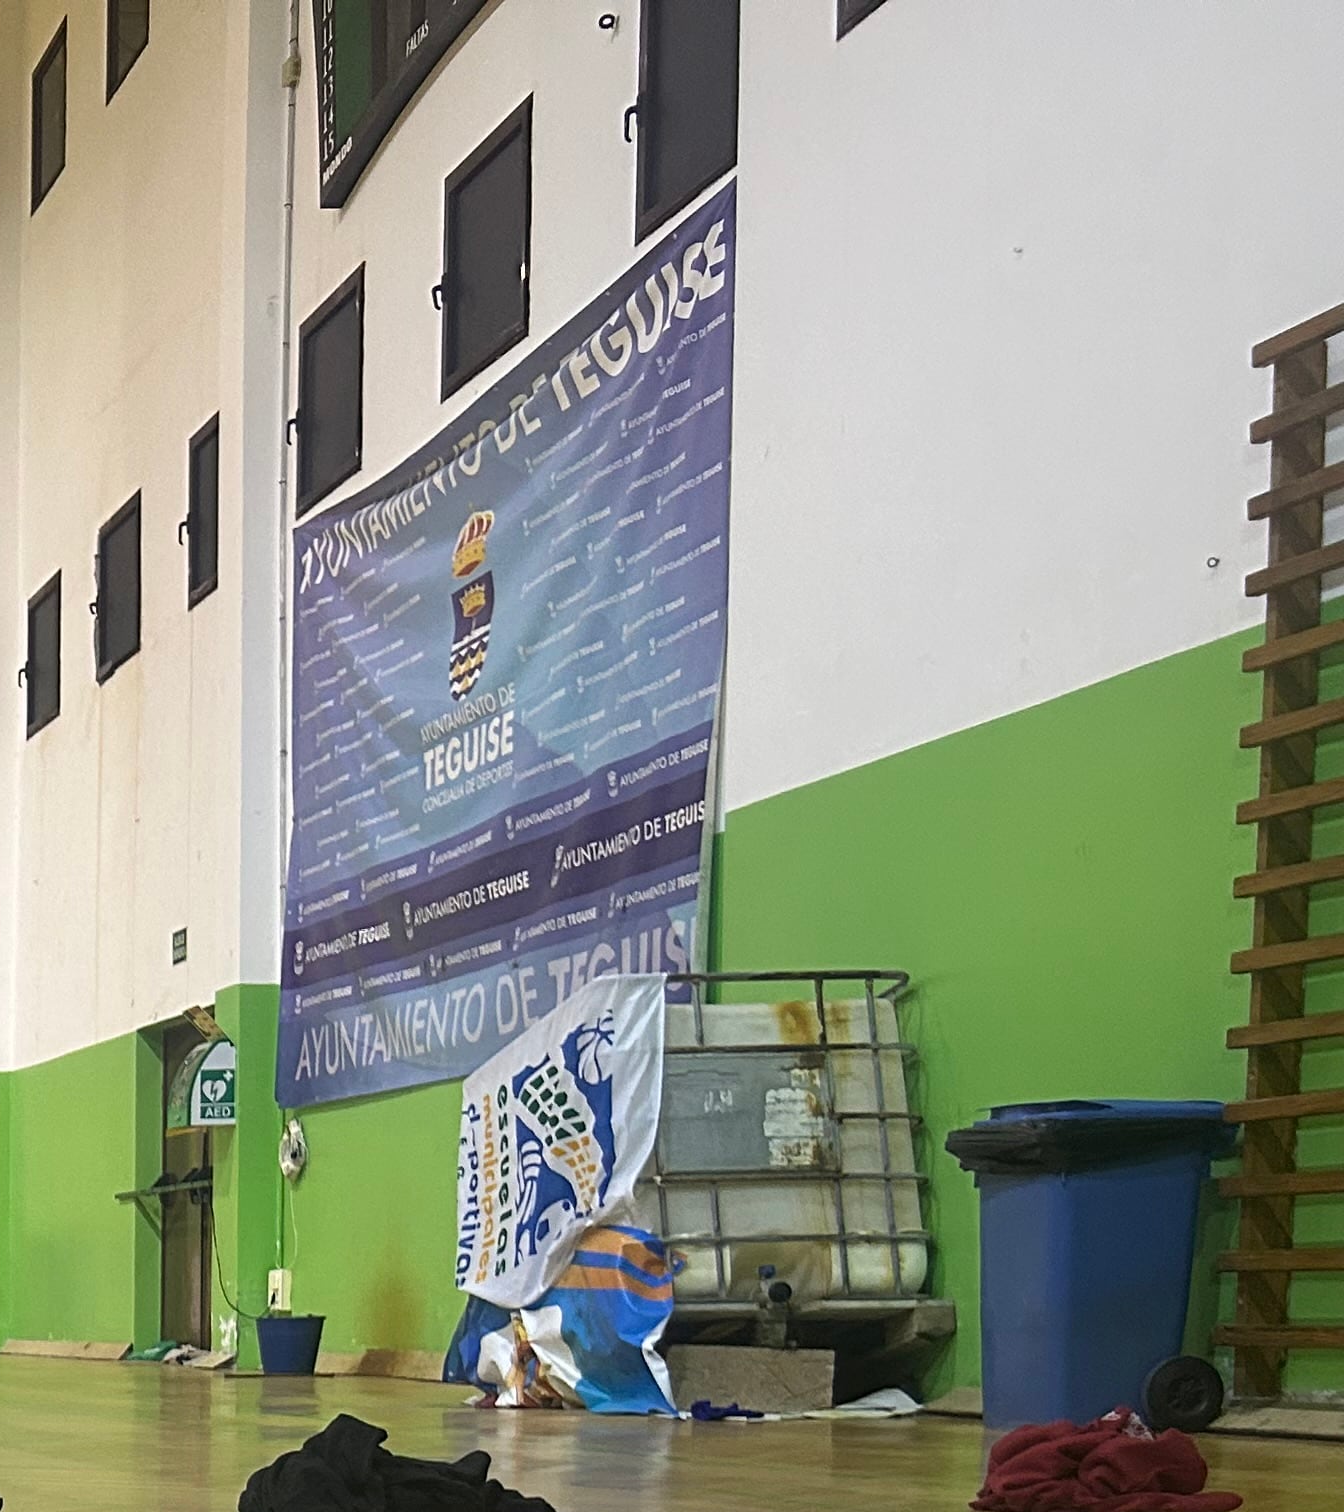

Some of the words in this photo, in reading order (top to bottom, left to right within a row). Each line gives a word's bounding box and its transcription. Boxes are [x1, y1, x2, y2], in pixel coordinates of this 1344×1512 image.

[405, 19, 429, 57] FALTAS
[550, 218, 726, 412] TEGUISE
[420, 693, 497, 745] AYUNTAMIENTO
[498, 681, 515, 708] DE
[423, 710, 514, 791] TEGUISE
[561, 825, 641, 871] AYUNTAMIENTO
[643, 817, 662, 841] DE
[664, 799, 705, 834] TEGUIS
[357, 921, 391, 945] TEGUISE
[413, 892, 472, 927] AYUNTAMIENTO
[473, 885, 487, 905] DE
[486, 870, 530, 901] TEGUISE
[294, 988, 486, 1081] AYUNTAMIENTO
[496, 968, 539, 1037] DE
[547, 915, 696, 1010] TEGUIS
[205, 1105, 231, 1118] AED
[455, 1103, 481, 1288] dportivas
[475, 1093, 499, 1284] municipales
[495, 1084, 512, 1277] escuelas
